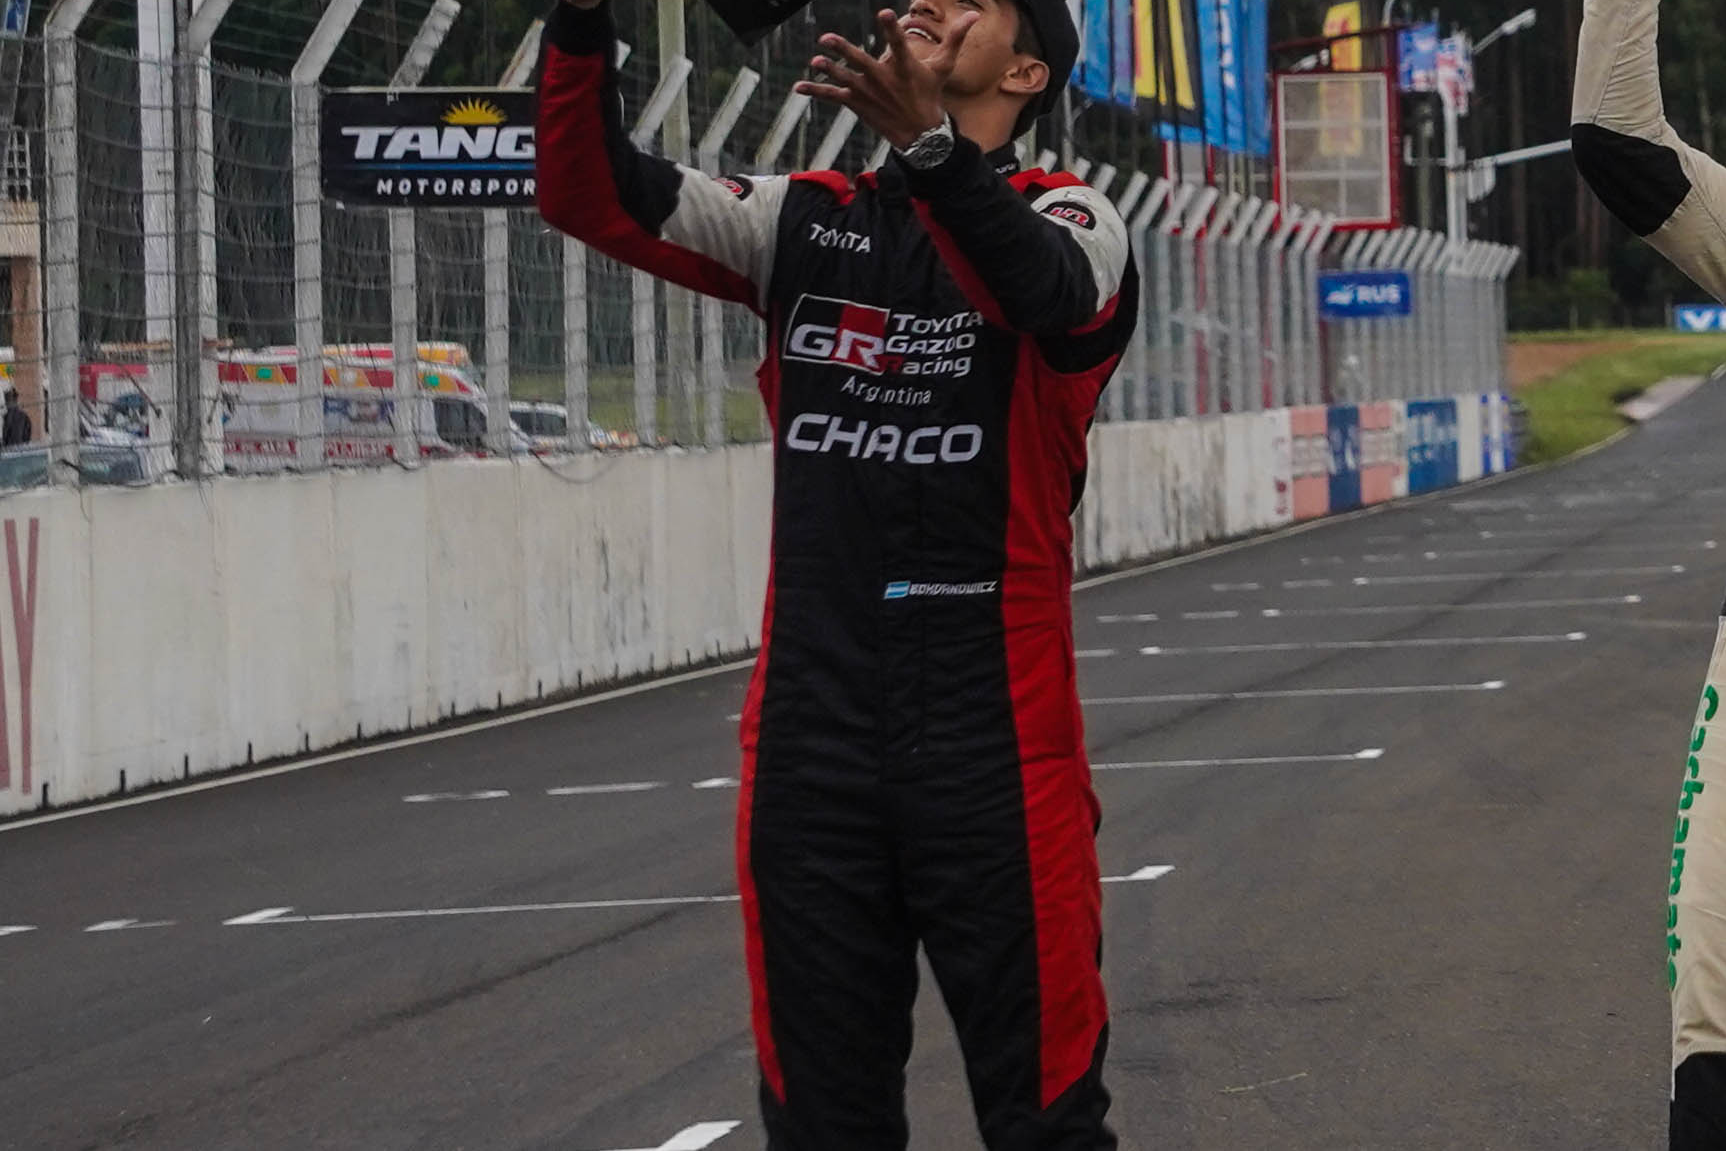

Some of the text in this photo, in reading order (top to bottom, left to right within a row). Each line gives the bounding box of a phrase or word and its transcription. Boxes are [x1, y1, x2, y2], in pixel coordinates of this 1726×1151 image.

[341, 125, 536, 161] TANG
[376, 178, 536, 196] MOTORSPOR
[790, 323, 886, 368] GR
[841, 375, 932, 405] Argntina
[786, 412, 983, 465] CHACO
